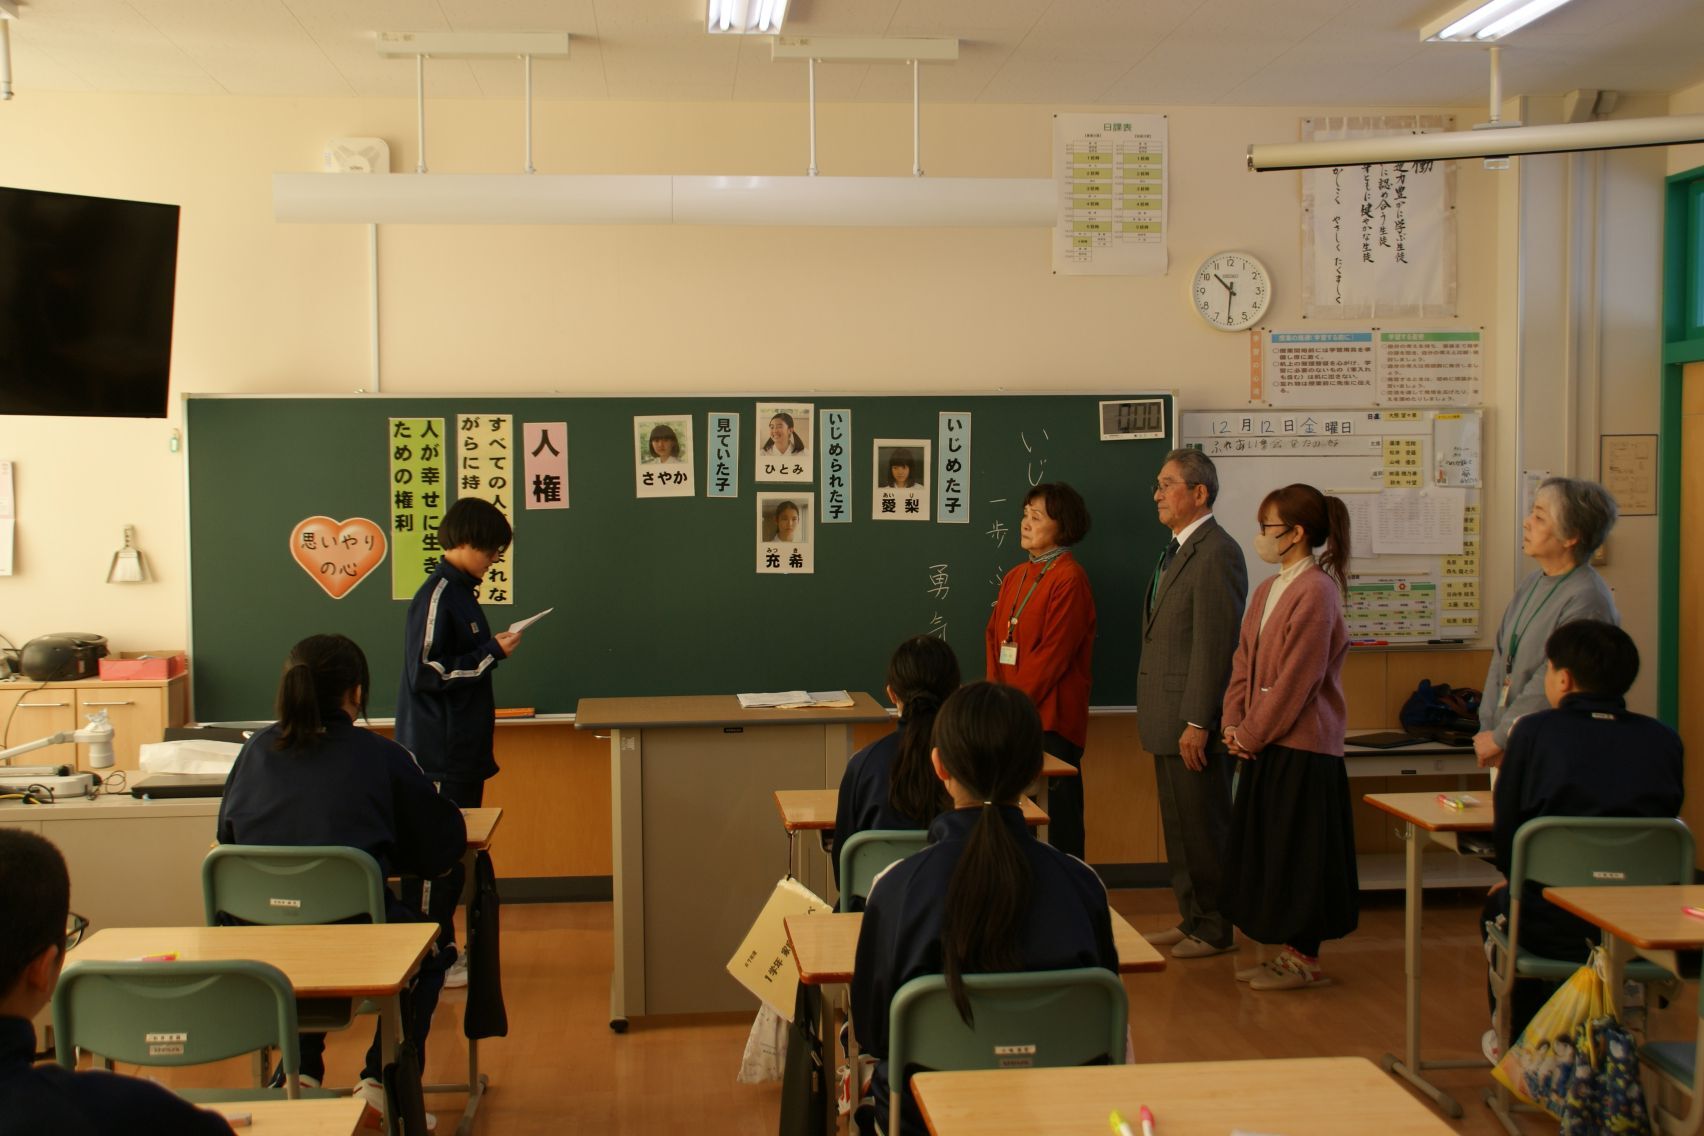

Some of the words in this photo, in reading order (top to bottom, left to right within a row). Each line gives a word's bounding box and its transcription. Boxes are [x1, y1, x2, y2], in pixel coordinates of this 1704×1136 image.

[1103, 123, 1132, 132] 日課表
[1226, 259, 1235, 267] 12
[1242, 262, 1246, 271] 1
[1203, 272, 1211, 281] 10
[1251, 271, 1258, 280] 2
[1199, 287, 1206, 295] 9
[1255, 287, 1262, 296] 3
[1203, 301, 1210, 310] 8
[1251, 301, 1258, 309] 4
[1214, 311, 1220, 320] 7
[1227, 315, 1234, 324] 6
[1241, 311, 1248, 320] 5
[715, 418, 731, 492] 見ていた子
[531, 429, 562, 503] 人権
[764, 464, 804, 475] ひとみ
[828, 412, 844, 519] いじめられた子
[945, 418, 963, 514] いじめた子
[393, 421, 413, 532] ための権利
[642, 470, 688, 486] さやか
[420, 420, 440, 575] 人が幸せに生き
[301, 532, 375, 551] 思いやり
[320, 561, 358, 577] の心
[764, 956, 784, 983] 1学年
